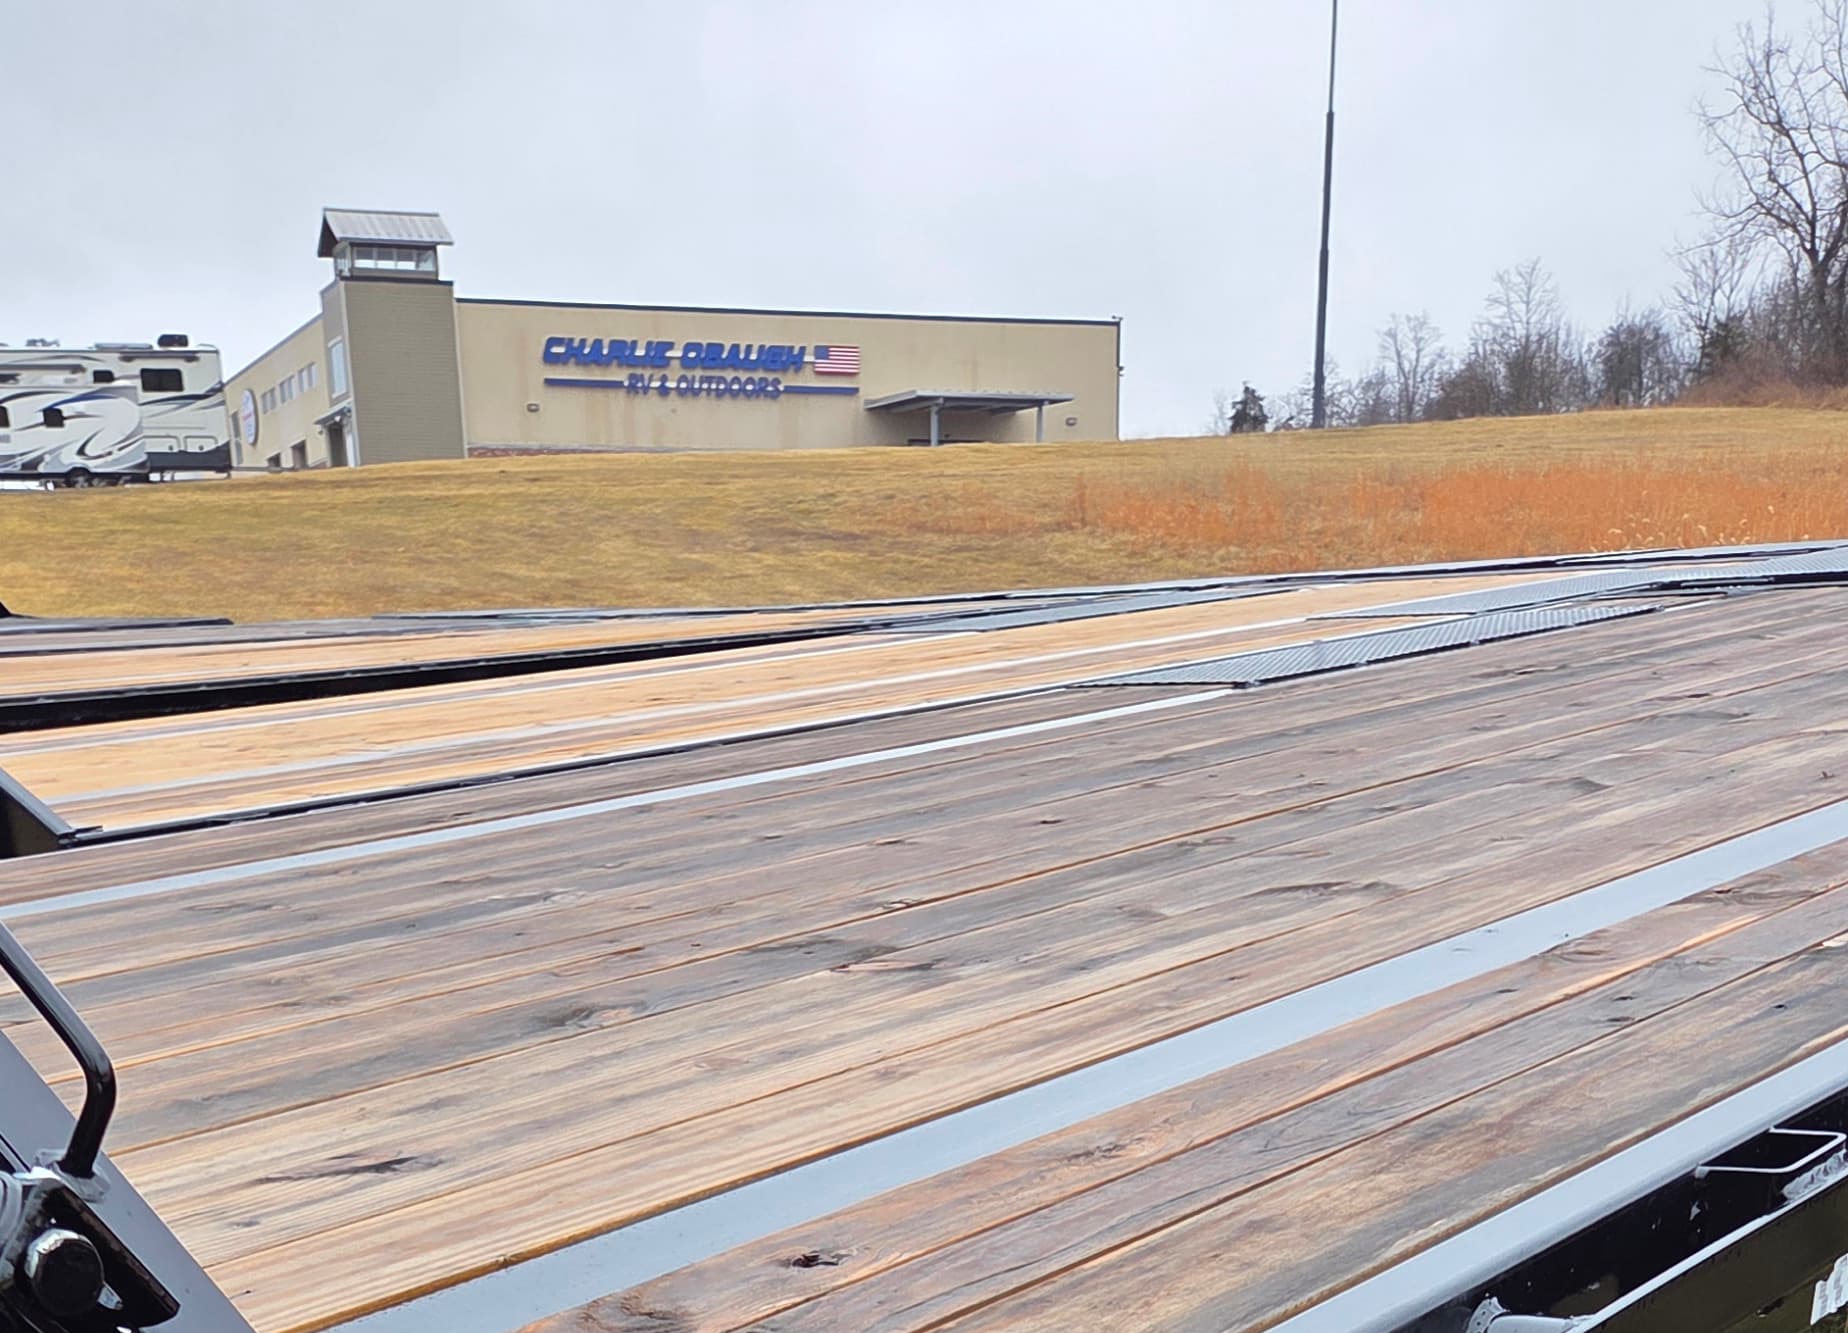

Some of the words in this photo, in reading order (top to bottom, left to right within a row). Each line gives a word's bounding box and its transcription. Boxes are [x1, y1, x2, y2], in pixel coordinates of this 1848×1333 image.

[543, 336, 675, 368] CHARLIE
[680, 342, 805, 372] OBAUGH
[625, 372, 652, 396] RV
[659, 373, 670, 397] &
[676, 374, 783, 399] OUTDOORS
